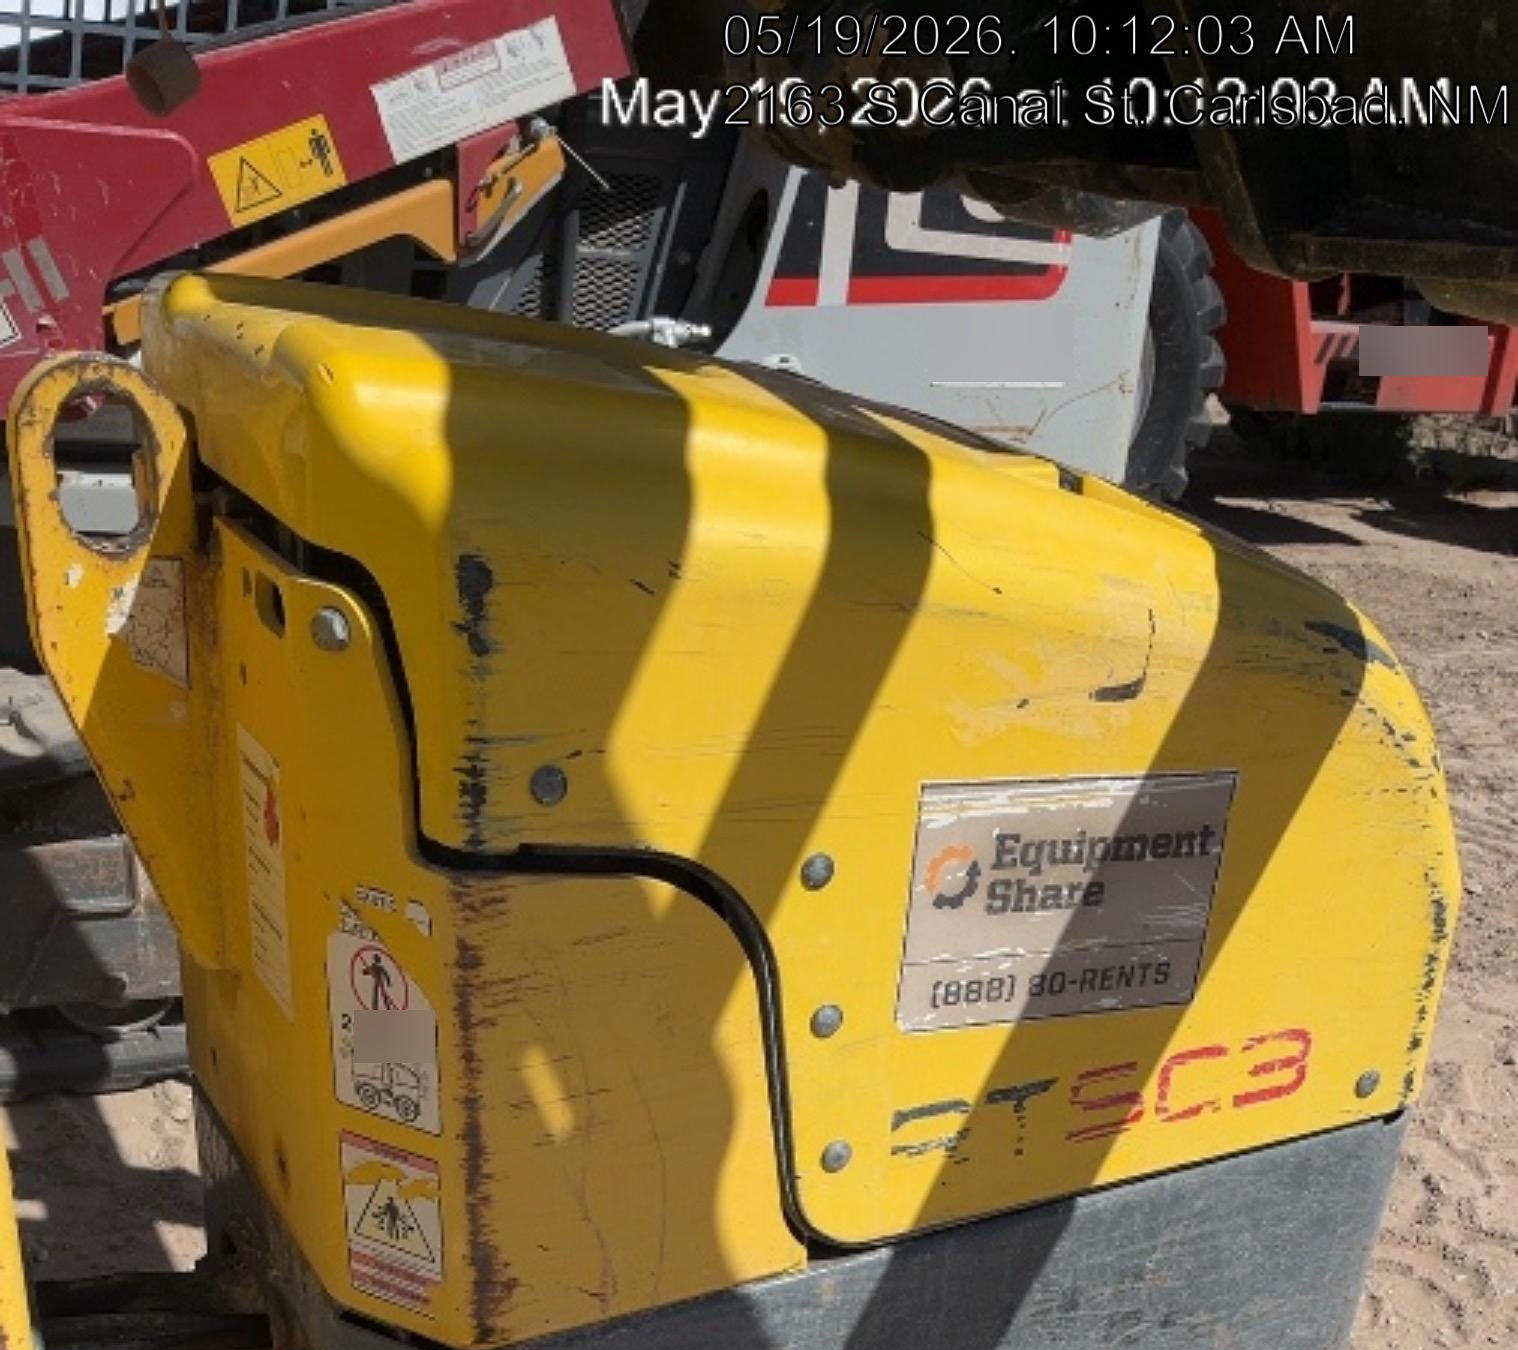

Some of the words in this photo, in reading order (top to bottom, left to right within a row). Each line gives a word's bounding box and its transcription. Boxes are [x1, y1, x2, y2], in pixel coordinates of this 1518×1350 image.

[989, 823, 1217, 878] Equipment
[984, 878, 1106, 915] Share
[930, 974, 1017, 1009] (888)
[1027, 961, 1172, 998] 80-RENTS
